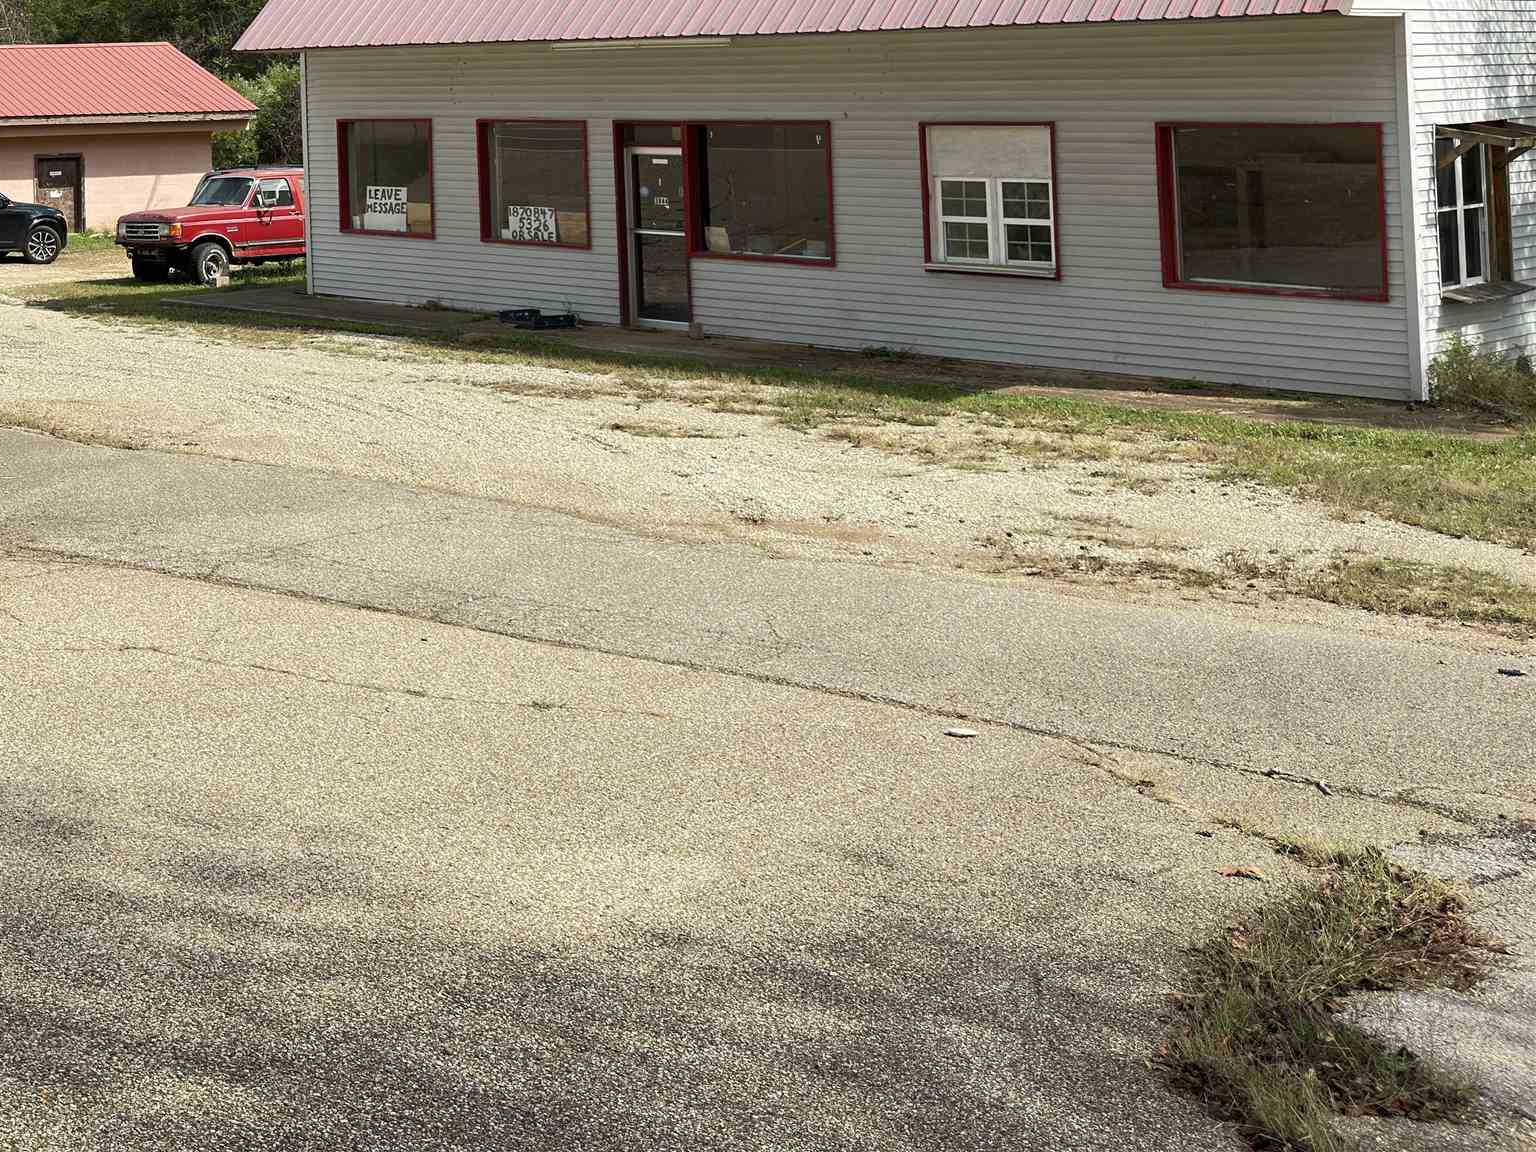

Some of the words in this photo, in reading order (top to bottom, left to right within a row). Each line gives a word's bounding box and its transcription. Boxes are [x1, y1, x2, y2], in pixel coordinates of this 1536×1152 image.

[368, 188, 402, 201] LEAVE
[366, 202, 407, 215] MESSAGE
[518, 217, 550, 232] 5326
